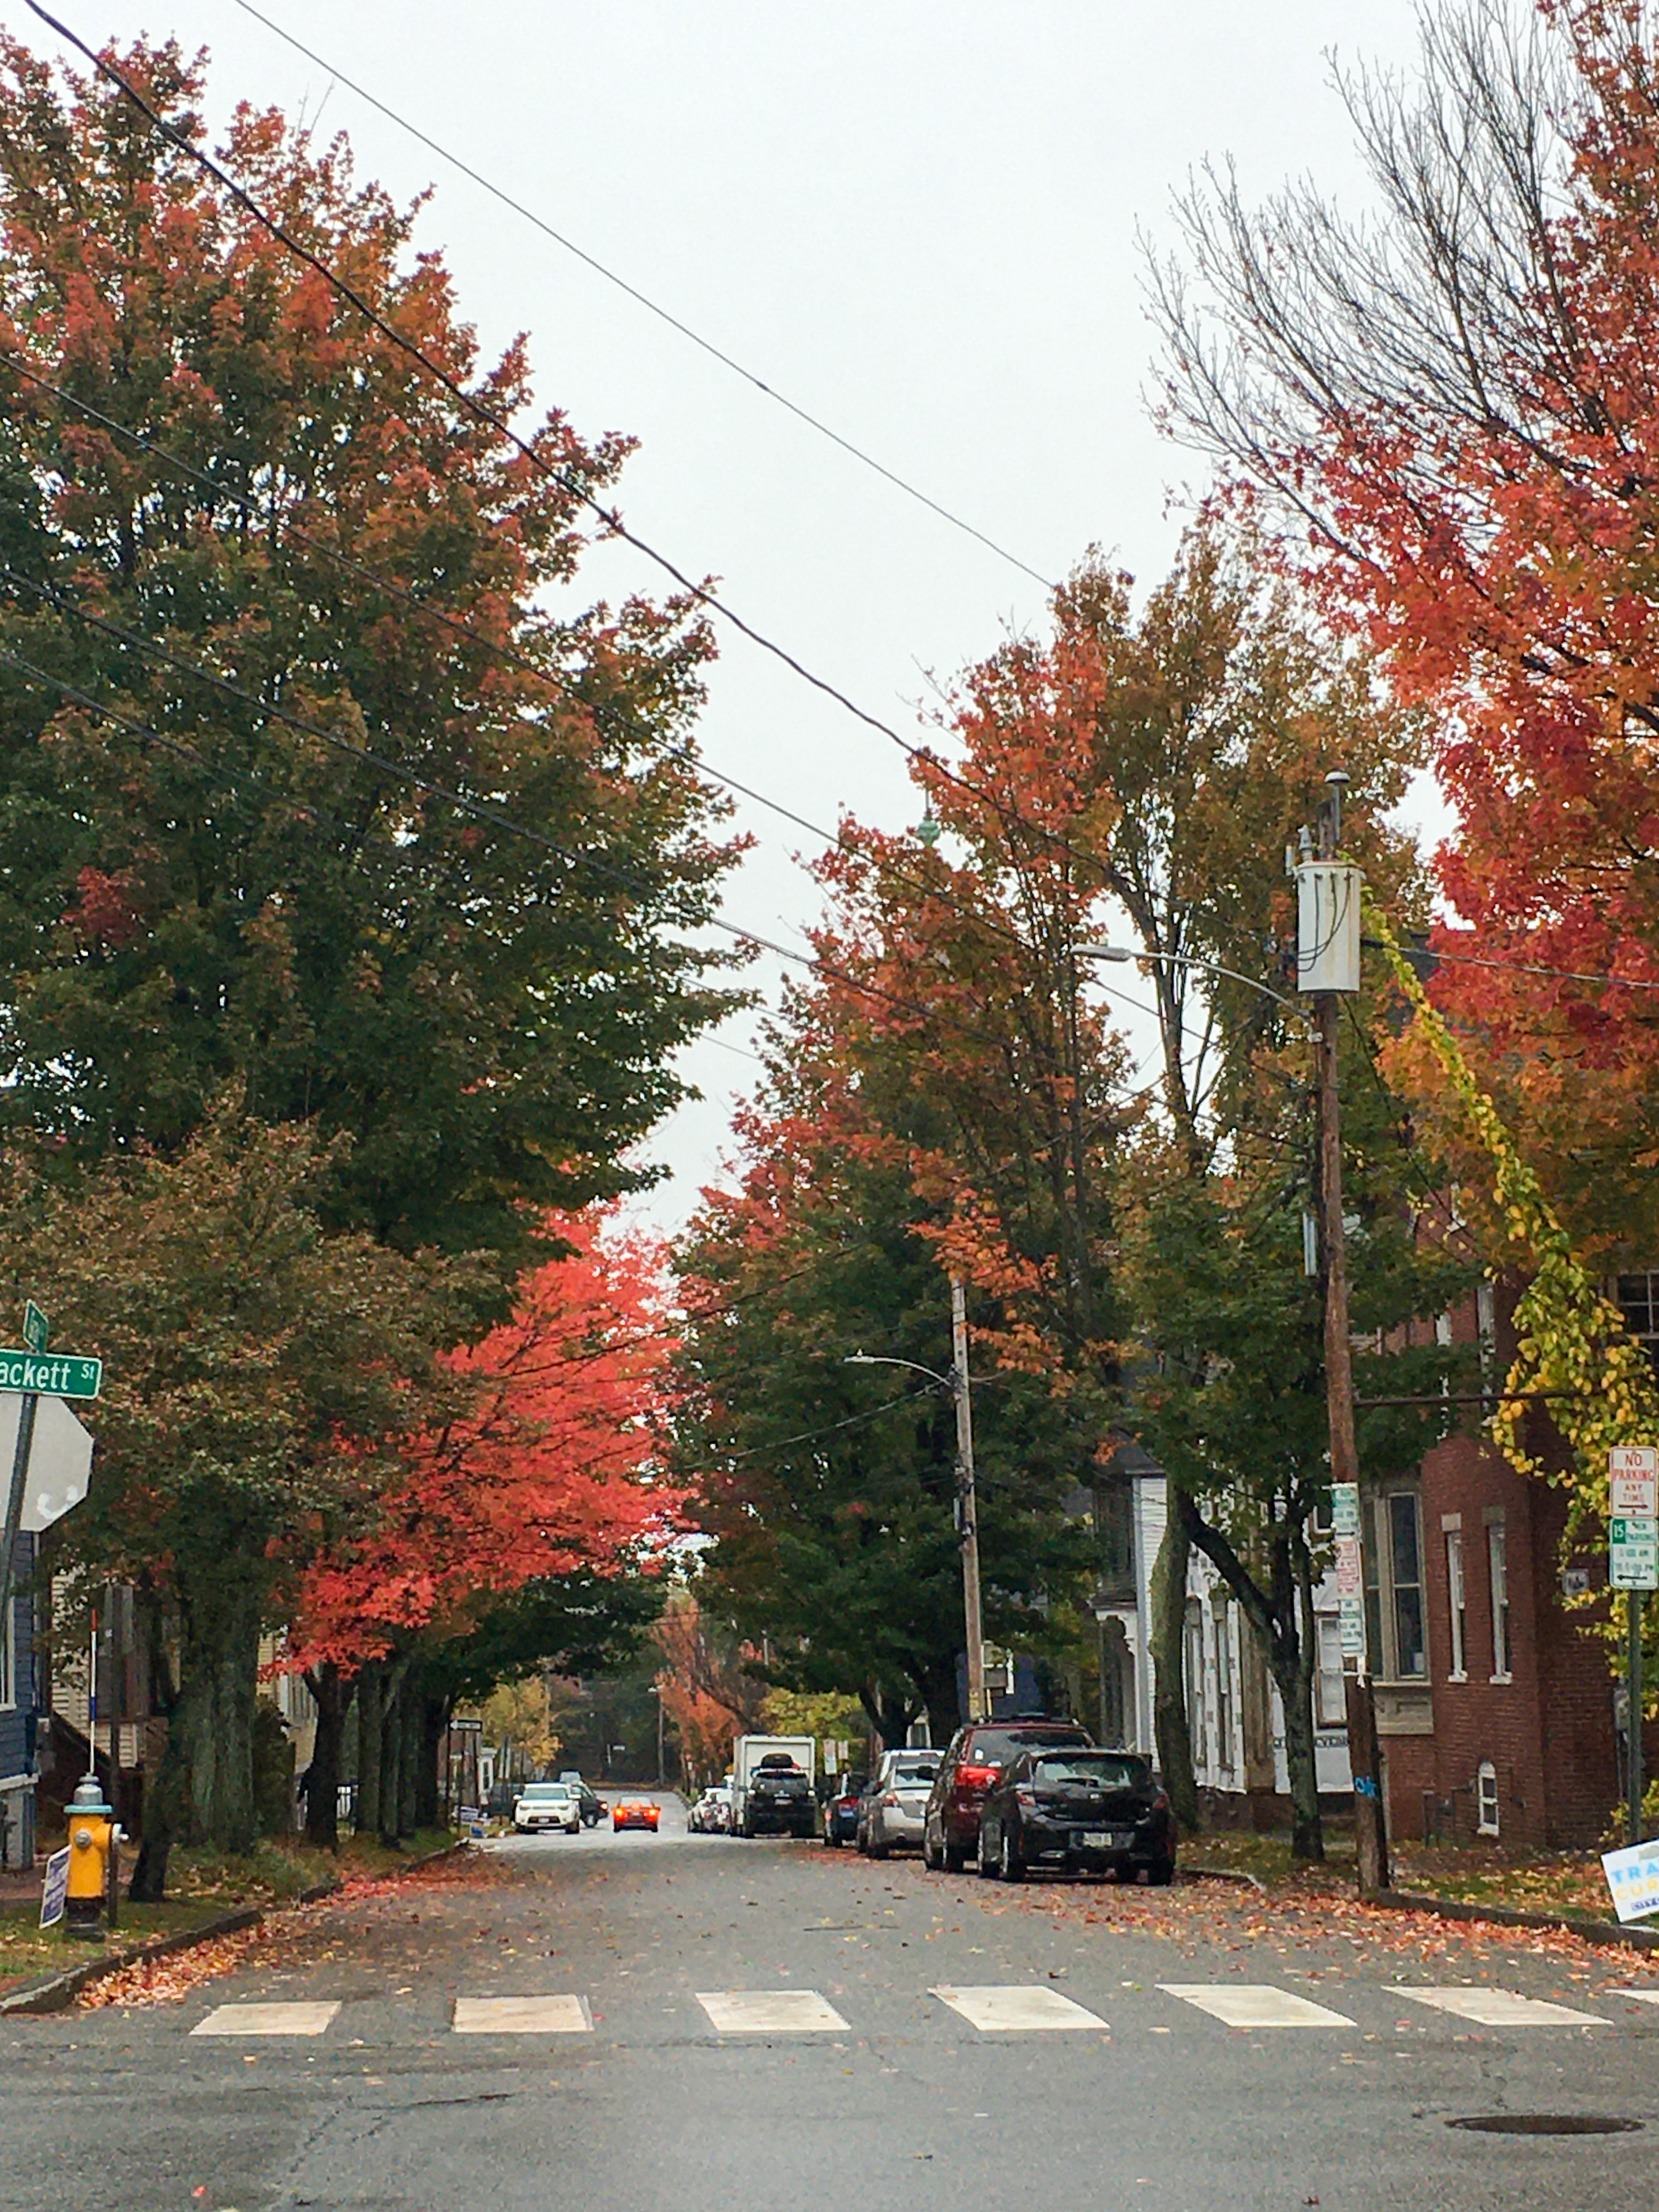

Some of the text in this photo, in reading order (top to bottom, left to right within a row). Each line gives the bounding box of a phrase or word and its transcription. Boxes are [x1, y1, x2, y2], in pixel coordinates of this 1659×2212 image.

[81, 1363, 95, 1379] St
[1625, 1454, 1642, 1466] NO
[1613, 1469, 1655, 1481] PARKING
[1626, 1484, 1642, 1492] ANY
[1623, 1493, 1644, 1501] TIME
[1613, 1524, 1624, 1539] 15
